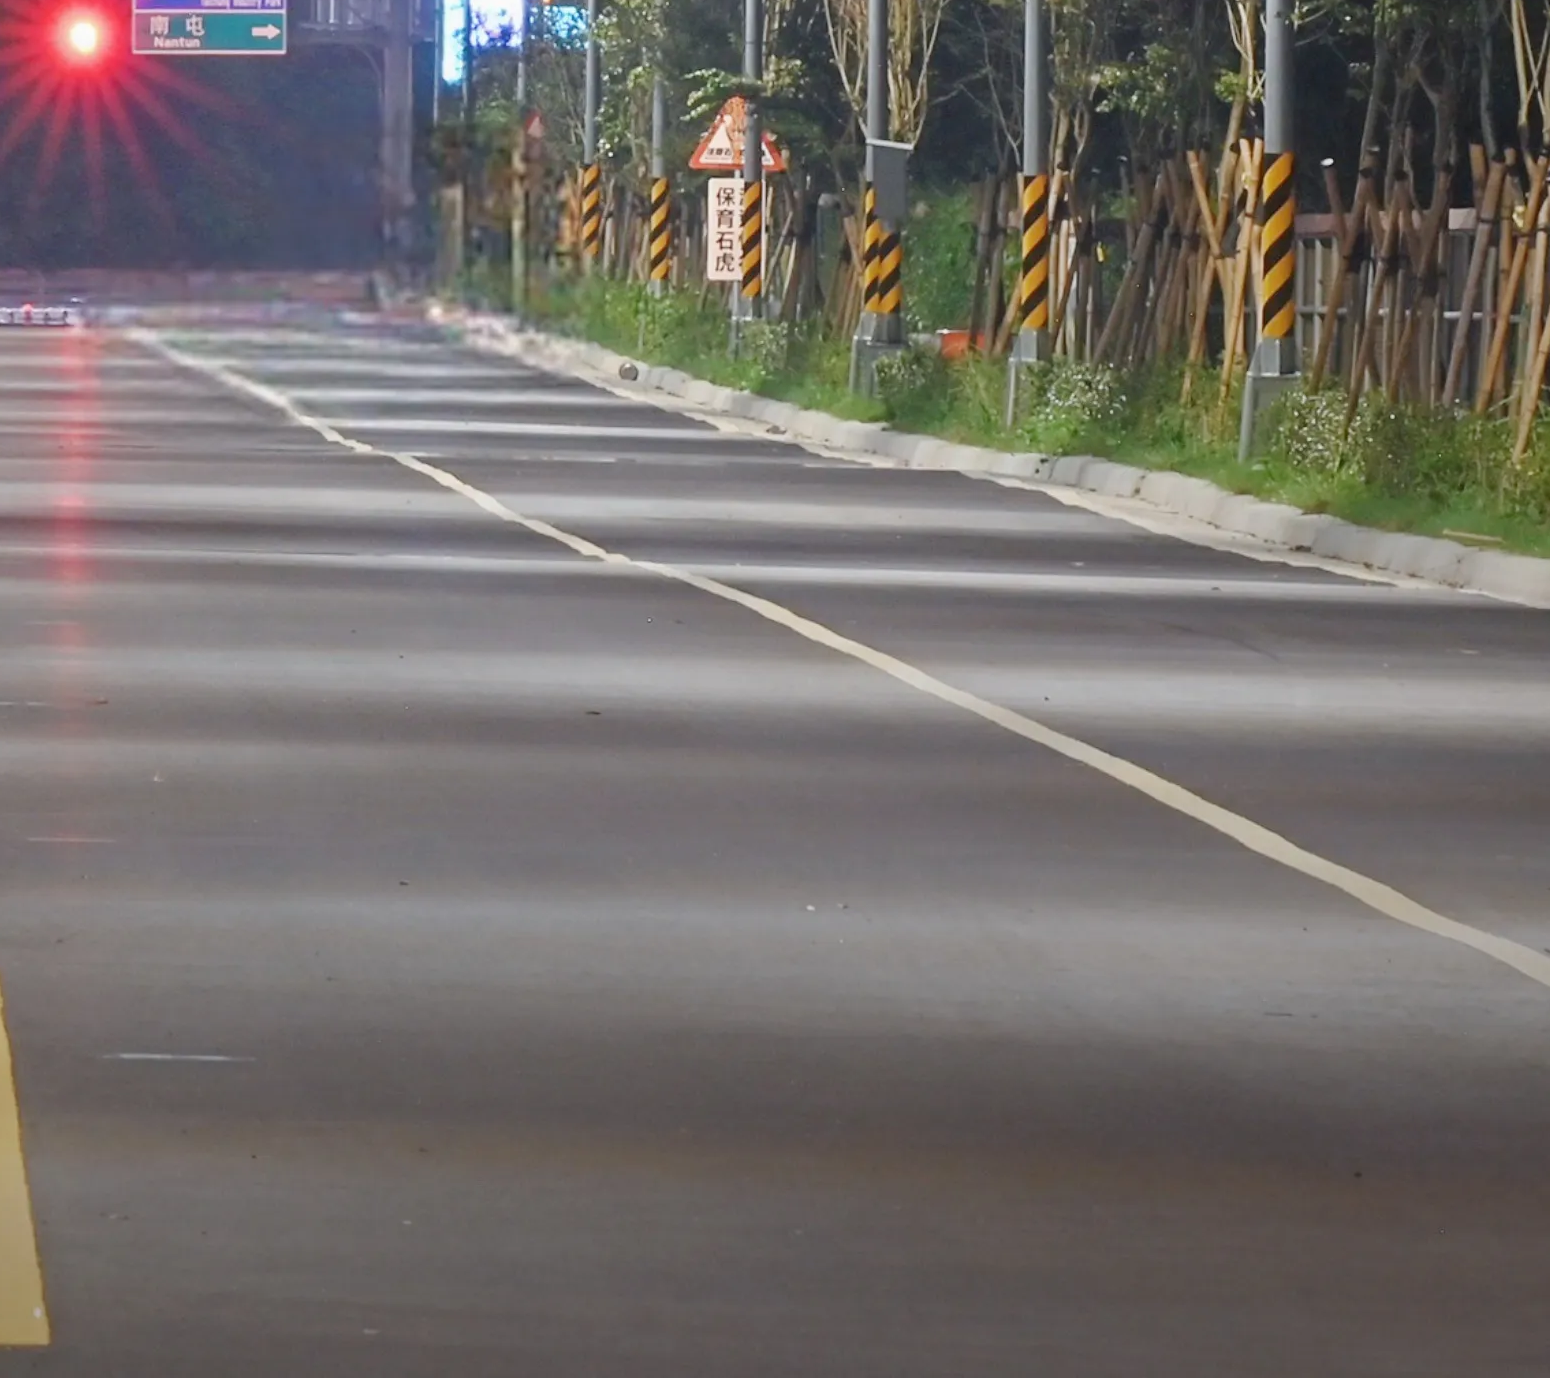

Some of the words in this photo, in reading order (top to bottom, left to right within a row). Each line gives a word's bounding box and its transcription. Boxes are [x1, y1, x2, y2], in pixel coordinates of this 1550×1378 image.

[150, 15, 205, 36] 南屯
[154, 36, 201, 48] Nantun
[714, 186, 736, 272] 保育石虎
